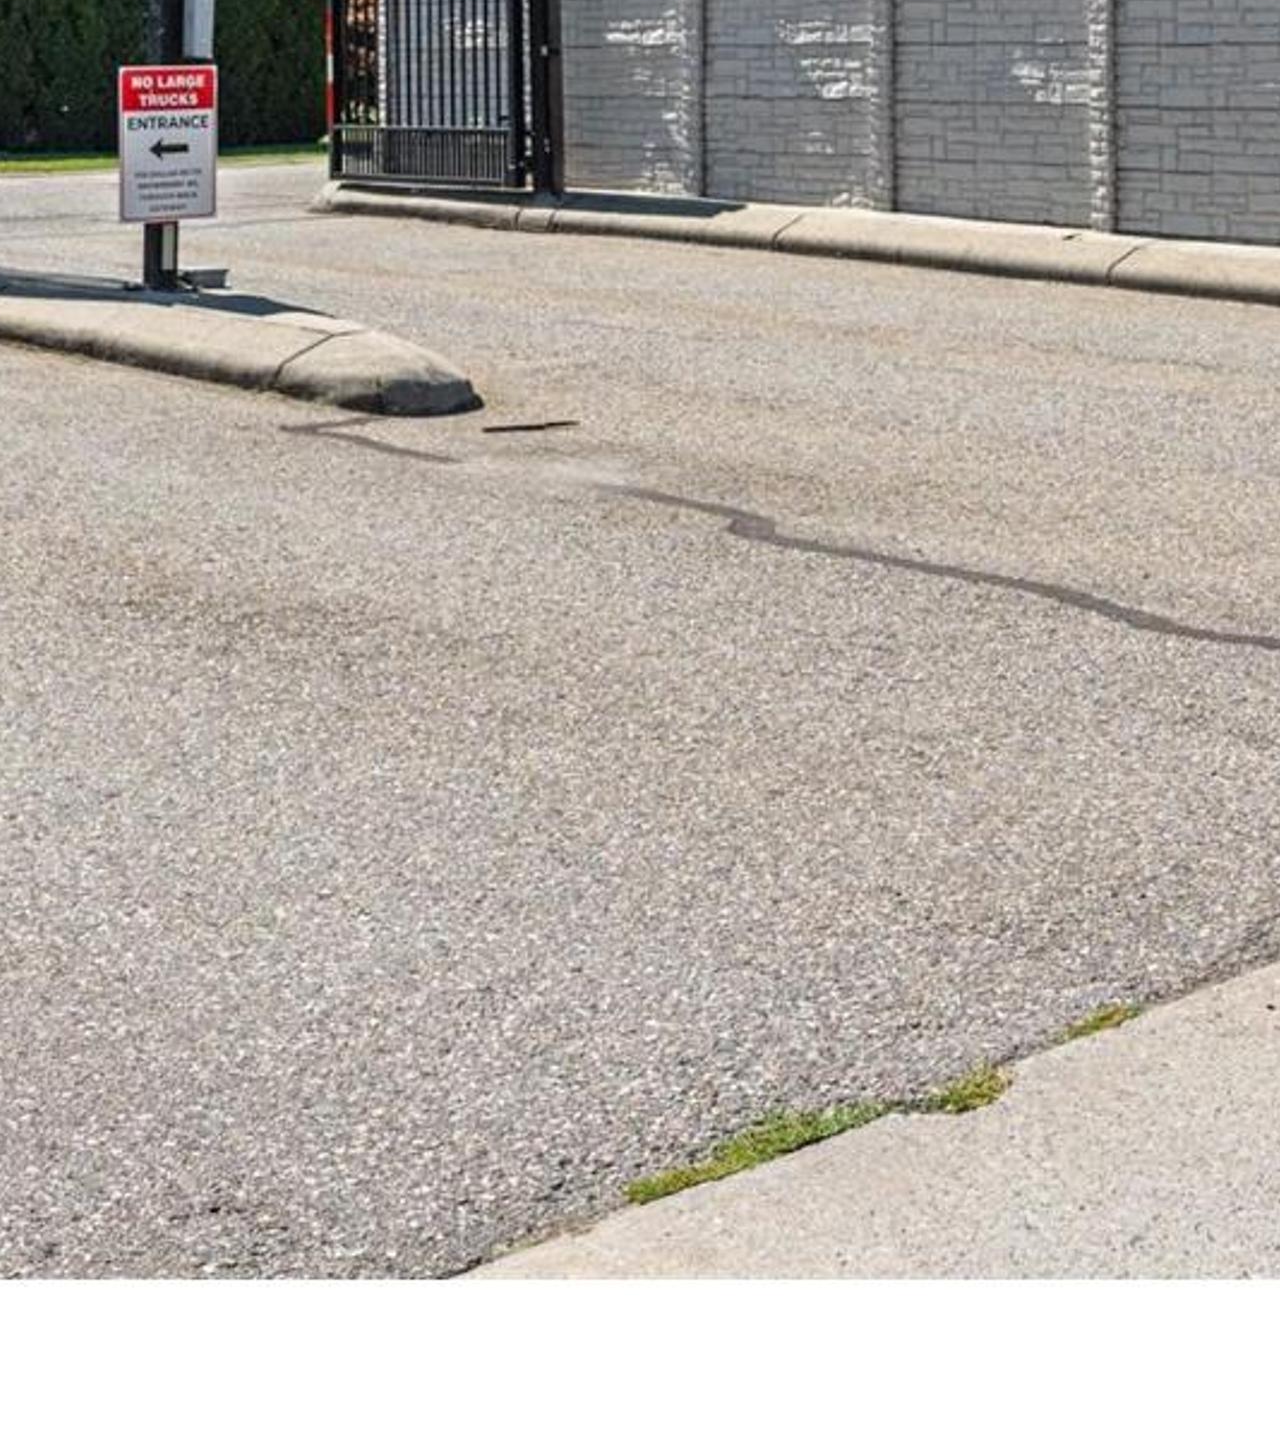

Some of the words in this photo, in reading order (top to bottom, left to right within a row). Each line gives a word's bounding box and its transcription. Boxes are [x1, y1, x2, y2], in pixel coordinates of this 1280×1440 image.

[131, 75, 154, 89] NO
[157, 74, 205, 89] LARGE
[138, 92, 199, 107] TRUCKS
[127, 114, 209, 130] ENTRANCE
